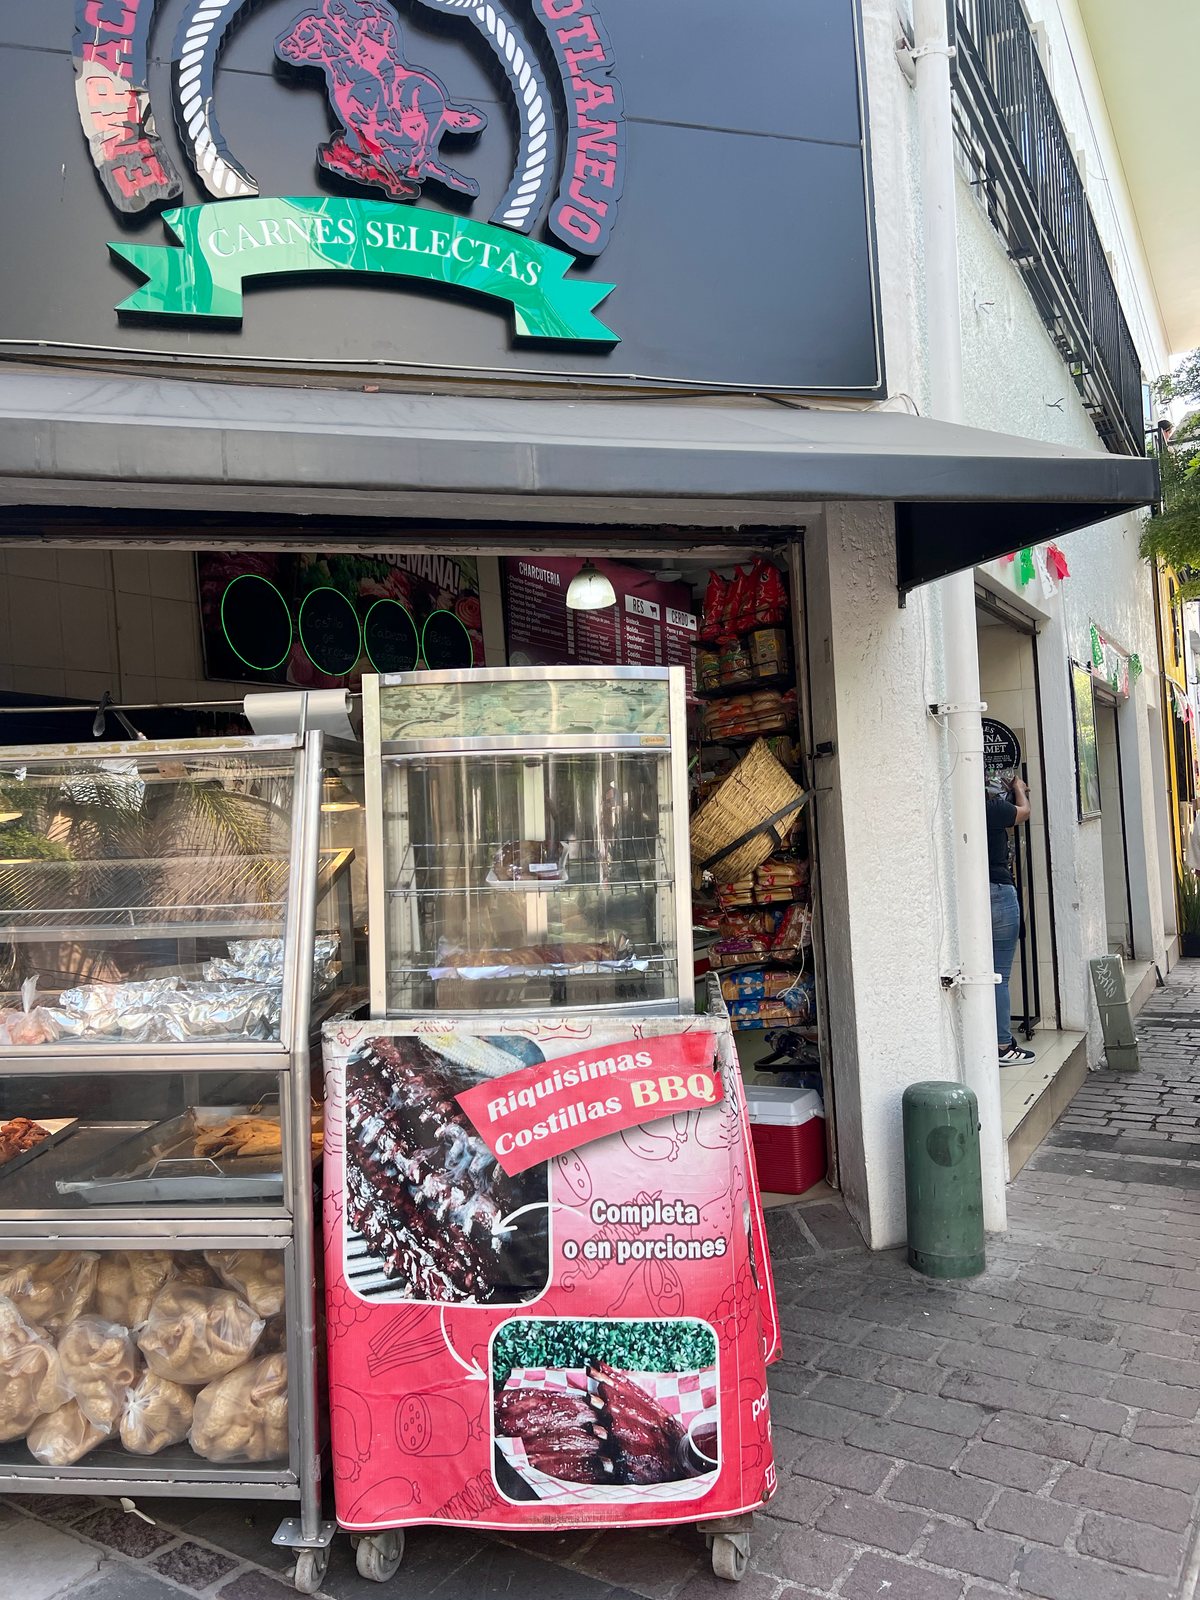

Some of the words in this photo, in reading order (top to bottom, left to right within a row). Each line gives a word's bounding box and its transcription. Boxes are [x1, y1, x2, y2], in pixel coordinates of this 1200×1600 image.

[208, 217, 355, 258] CARNES
[365, 220, 543, 286] SELECTAS
[518, 561, 561, 587] CHARCUTERIA
[632, 598, 645, 614] RES
[671, 610, 689, 627] CERDO
[983, 726, 995, 734] ES
[984, 734, 1003, 743] NA
[486, 1051, 653, 1123] Riquisimas
[494, 1097, 622, 1156] Costillas
[629, 1073, 716, 1109] BBQ
[590, 1200, 699, 1226] Completa
[563, 1240, 577, 1259] o
[583, 1239, 614, 1260] en
[617, 1234, 727, 1264] porciones
